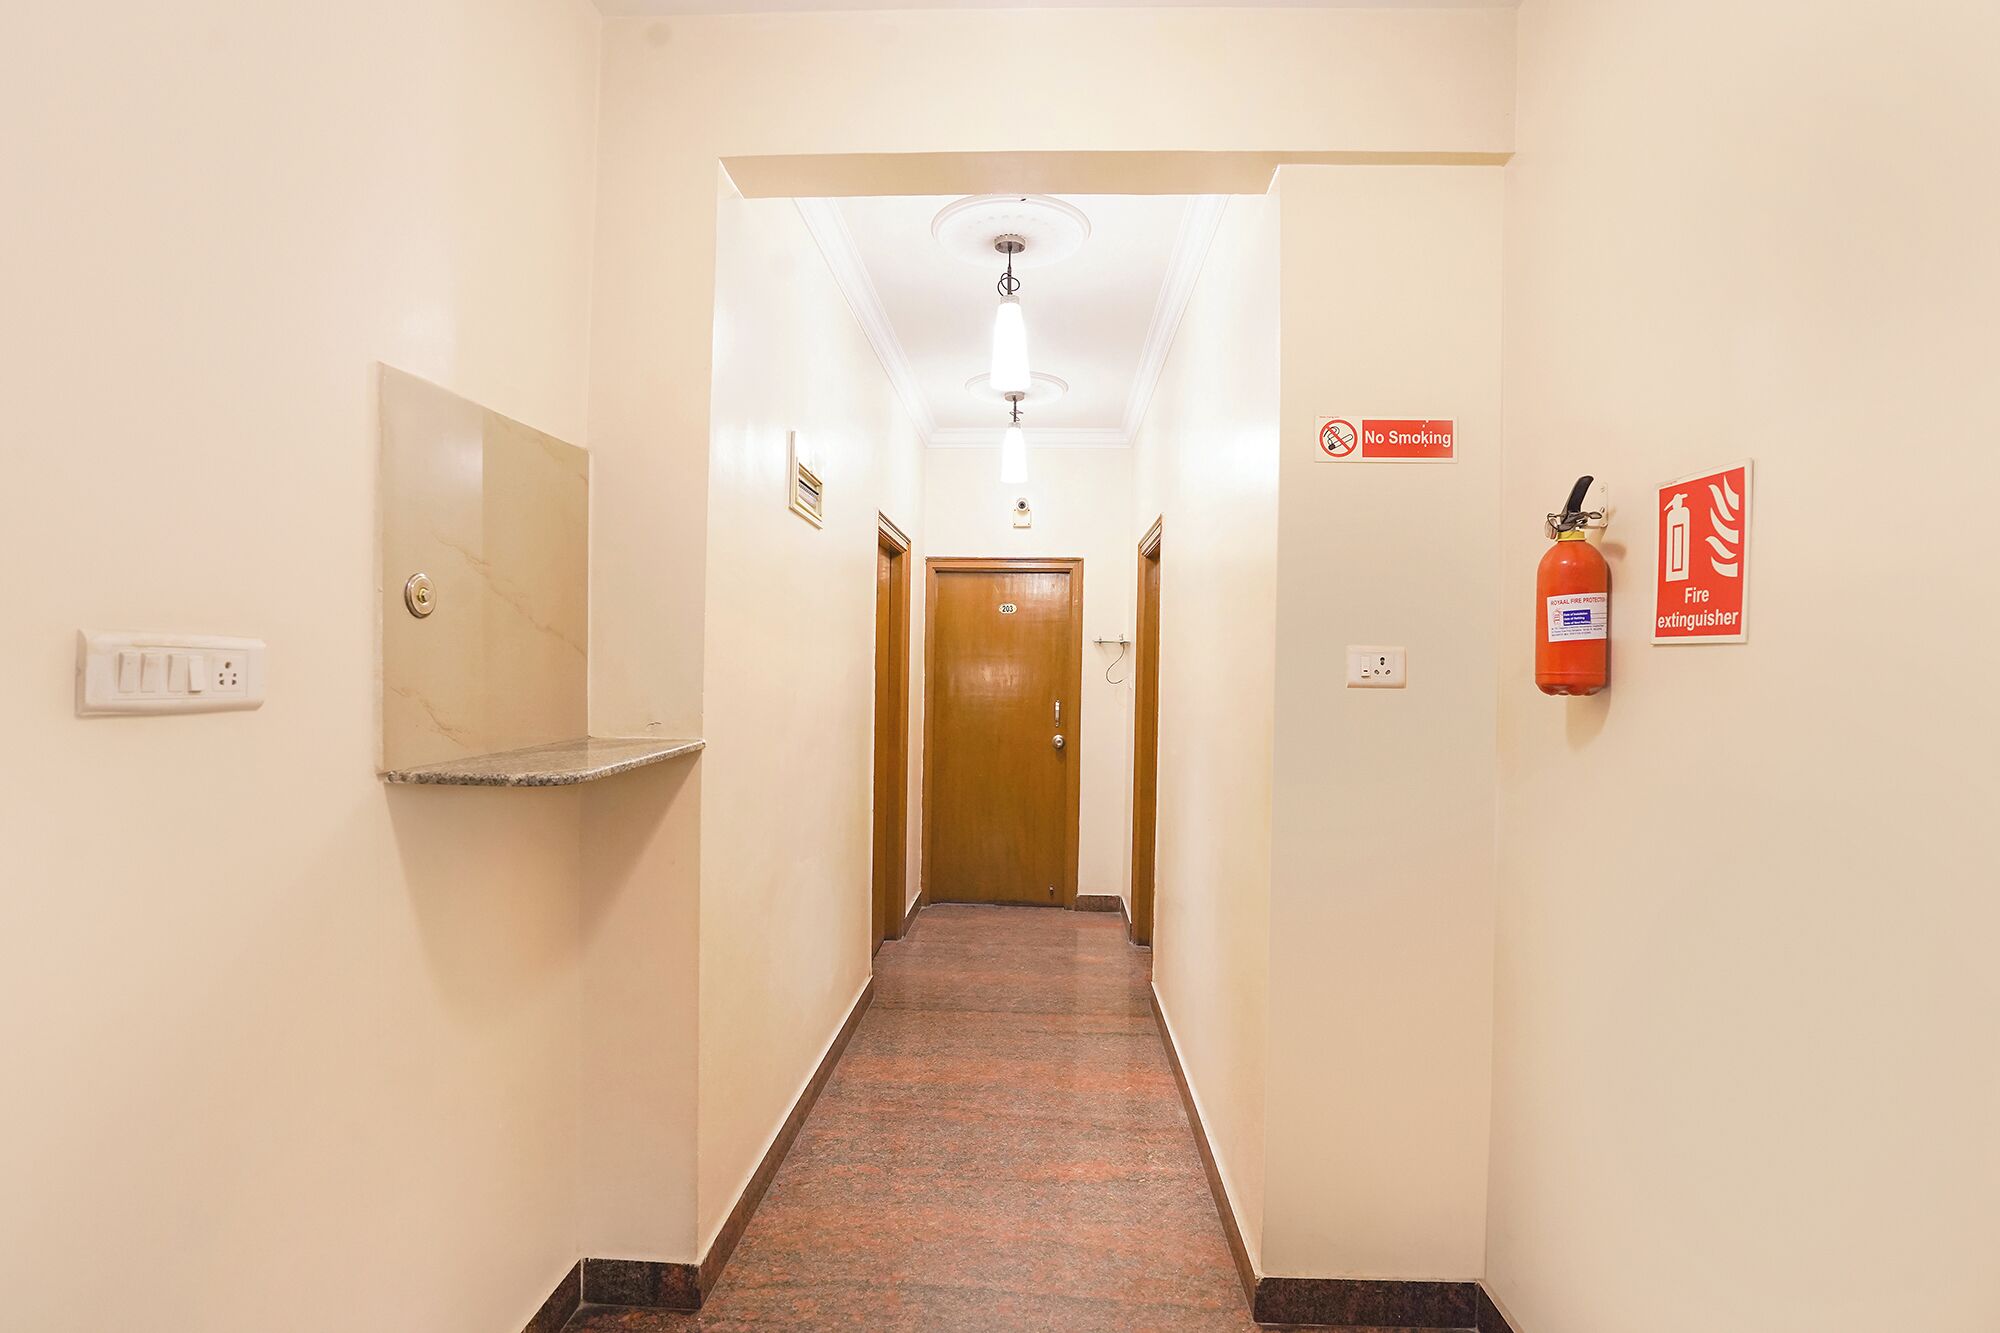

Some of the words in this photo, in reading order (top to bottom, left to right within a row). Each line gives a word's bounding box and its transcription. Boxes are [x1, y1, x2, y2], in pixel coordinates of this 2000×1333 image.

[1365, 430, 1385, 445] No
[1388, 430, 1452, 448] Smoking
[1684, 587, 1710, 604] Fire
[1657, 608, 1739, 631] extinguisher
